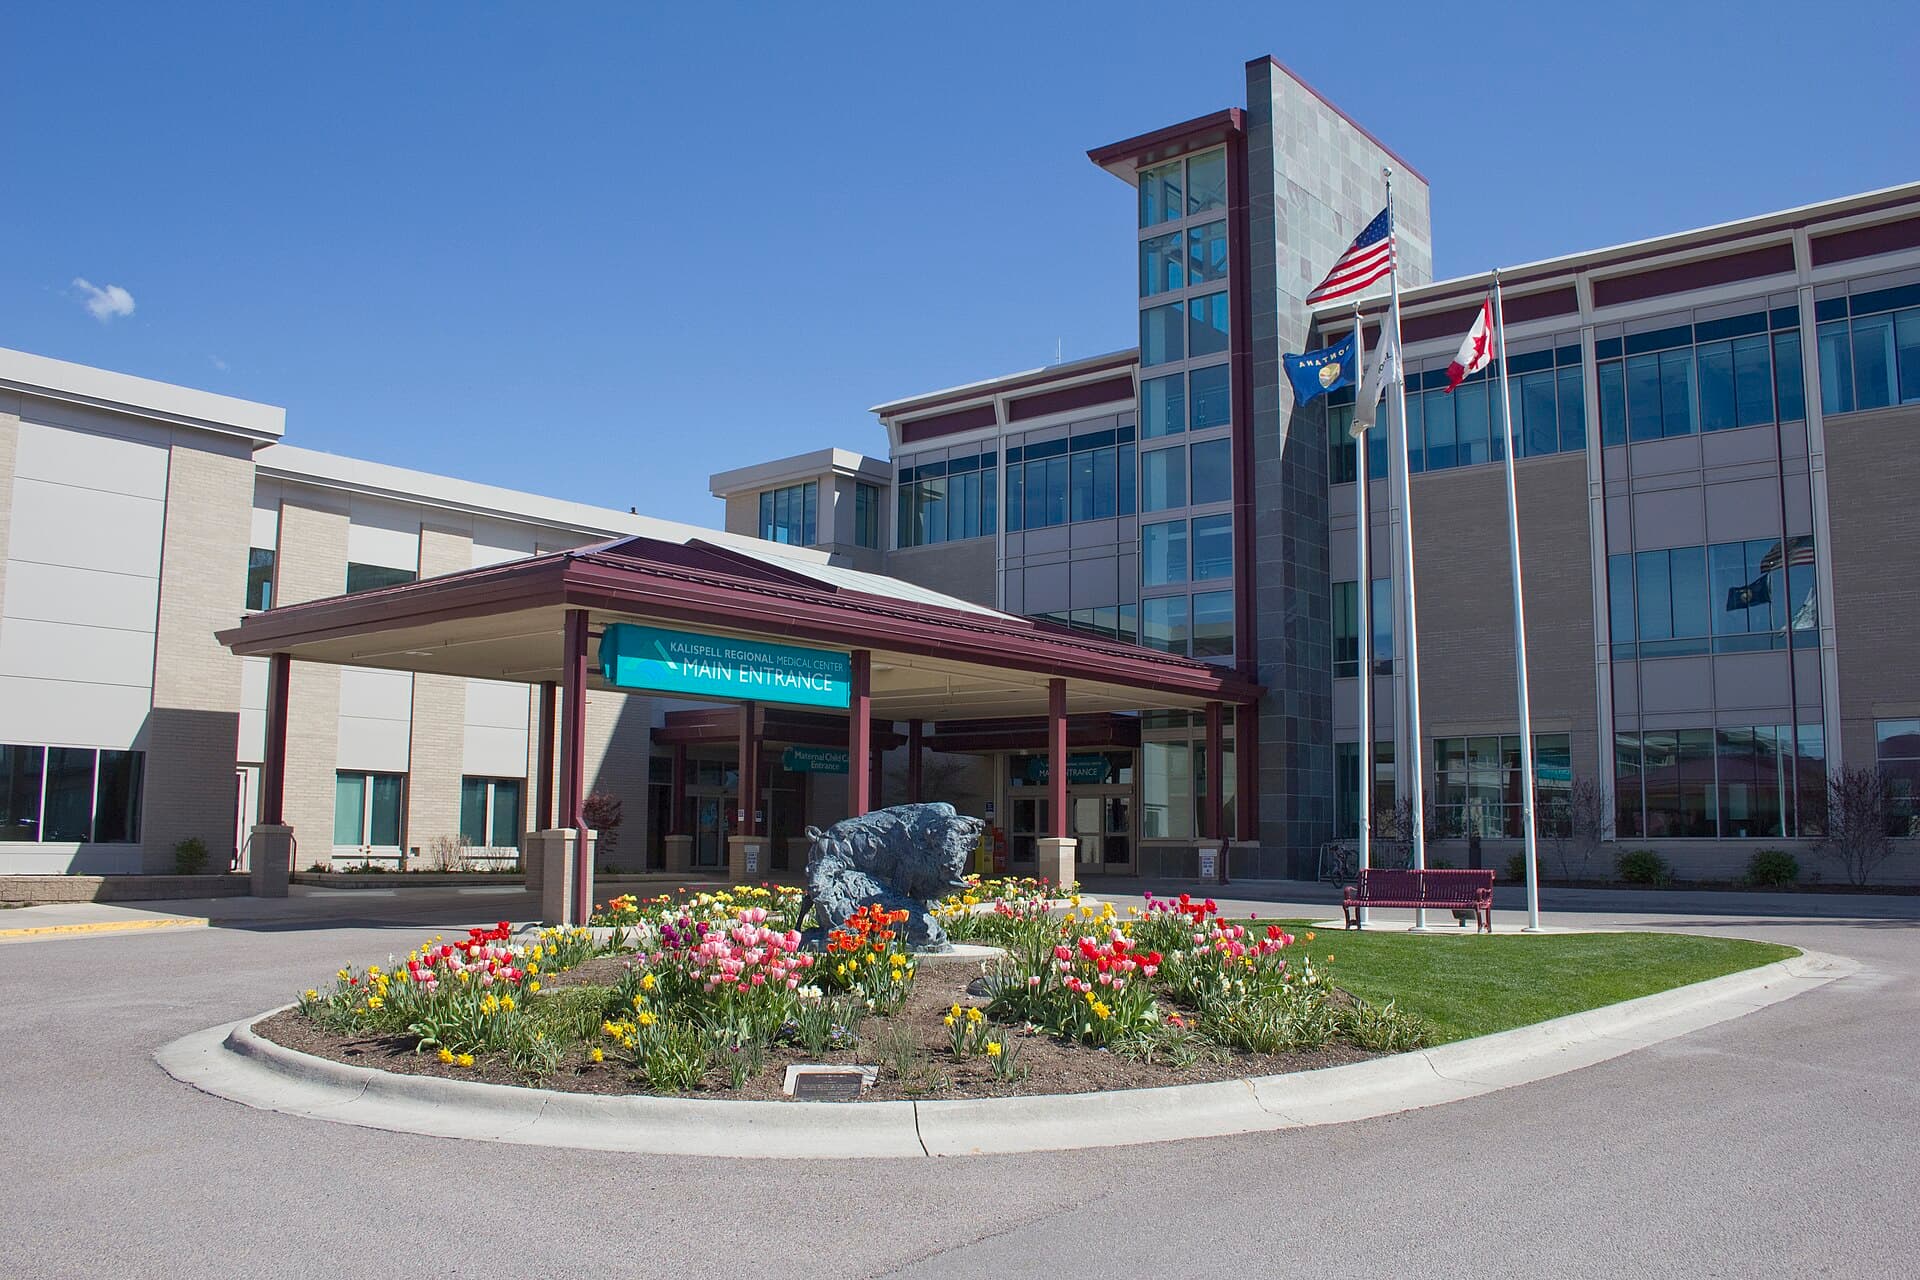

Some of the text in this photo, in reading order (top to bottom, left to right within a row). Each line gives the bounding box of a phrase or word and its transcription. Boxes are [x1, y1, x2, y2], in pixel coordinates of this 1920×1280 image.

[670, 641, 843, 672] KALISPELL REGIONAL MEDICAL CENTER
[683, 657, 833, 691] MAIN ENTRANCE
[794, 751, 824, 761] Maternal
[824, 752, 841, 762] Child
[810, 760, 840, 770] Entrance
